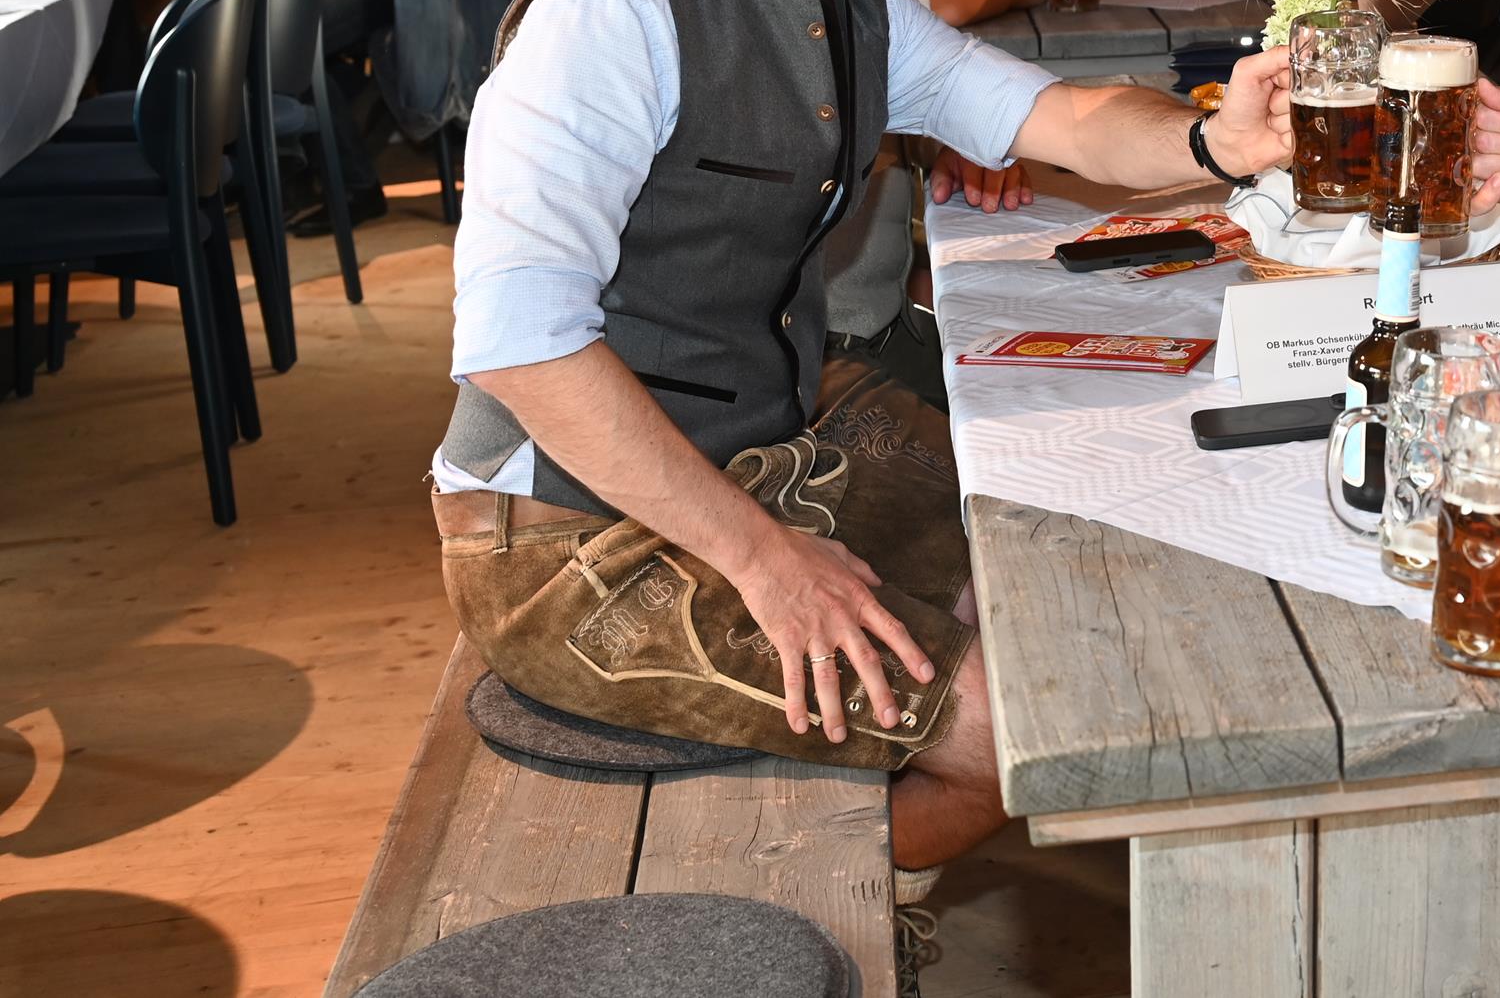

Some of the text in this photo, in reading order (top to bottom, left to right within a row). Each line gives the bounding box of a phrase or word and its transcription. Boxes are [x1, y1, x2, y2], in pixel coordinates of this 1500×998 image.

[1266, 340, 1280, 350] OB
[1282, 338, 1314, 348] Markus
[1293, 347, 1344, 358] Franz-Xaver
[1287, 360, 1314, 369] stellv.
